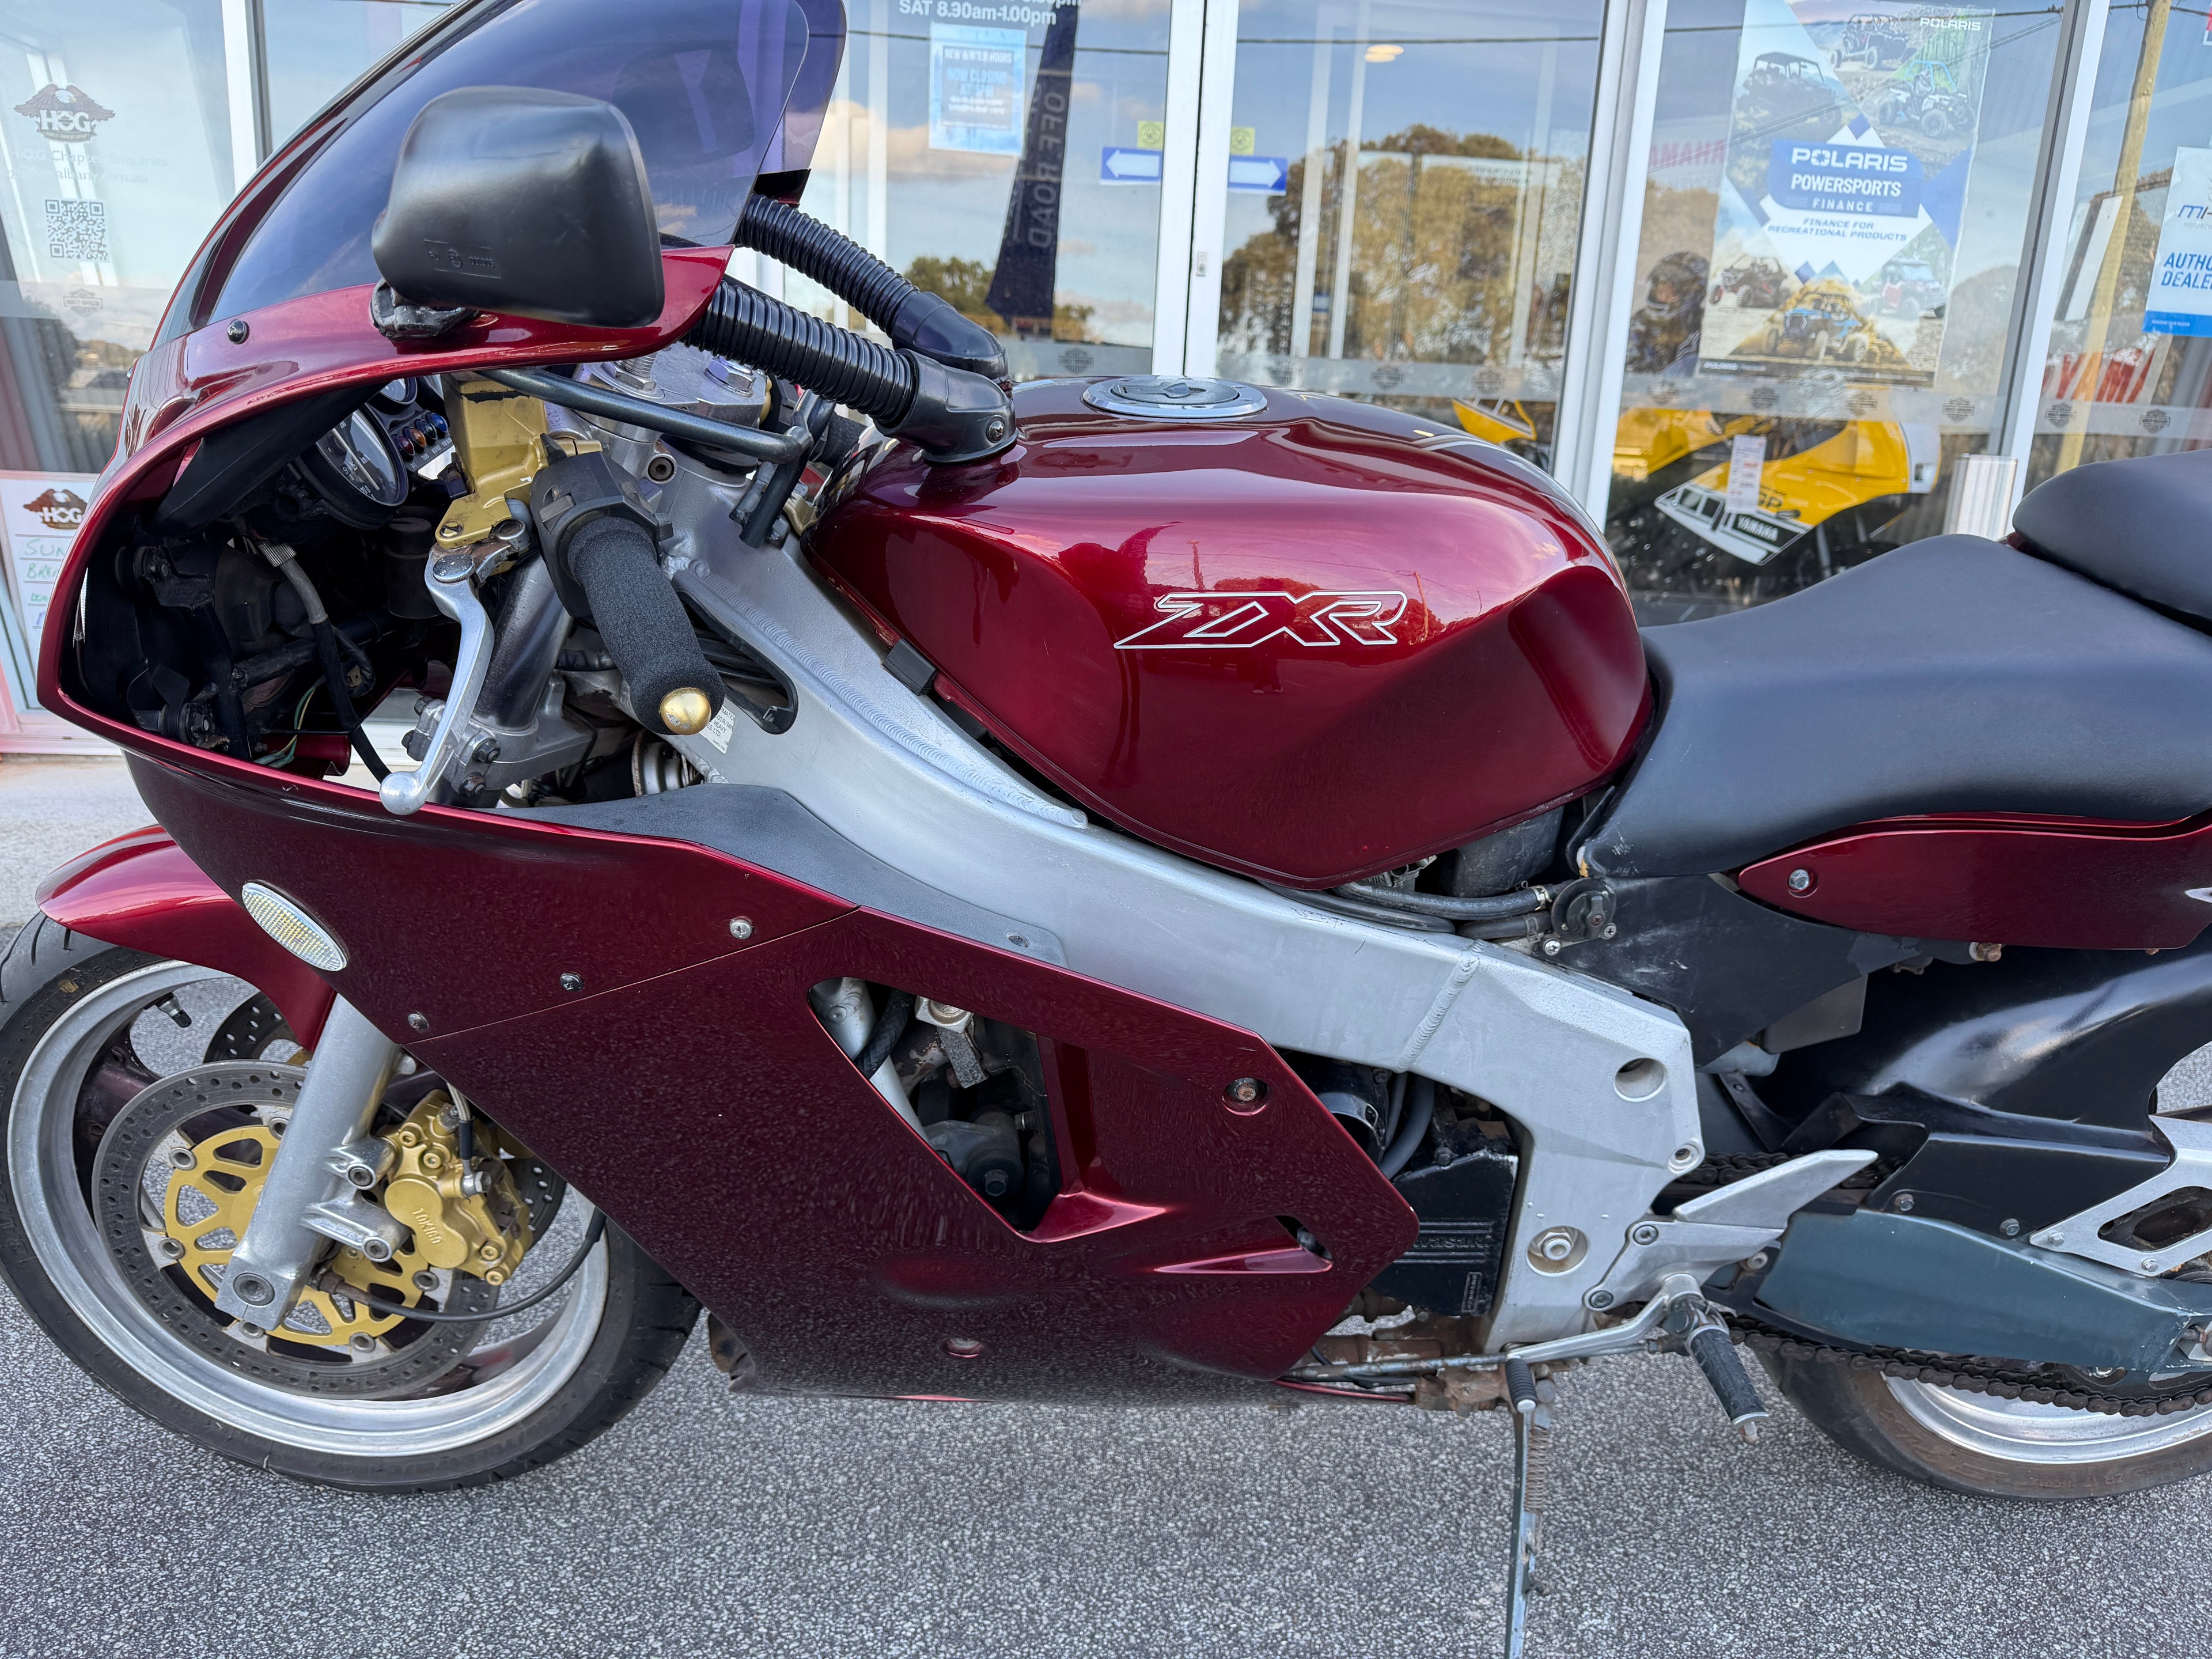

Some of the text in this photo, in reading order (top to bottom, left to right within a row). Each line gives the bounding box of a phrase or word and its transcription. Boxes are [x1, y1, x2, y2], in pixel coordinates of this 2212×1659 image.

[899, 0, 933, 16] SAT
[1919, 17, 1982, 31] POLARIS
[40, 110, 91, 132] HOG
[1649, 138, 1726, 166] AMAHA
[1791, 147, 1908, 172] POLARIS
[1791, 173, 1902, 196] POWERSPORTS
[1812, 198, 1874, 213] FINANCE
[1803, 217, 1874, 230] FINANCE FOR
[1768, 225, 1907, 242] RECREATIONAL PRODUCTS
[42, 507, 82, 523] HOG
[1736, 514, 1779, 542] YAMAHA
[1114, 591, 1407, 649] ZXR
[714, 720, 726, 733] HEAVY
[1423, 897, 1441, 906] FUEL
[412, 1208, 442, 1244] TOKICO
[1412, 1234, 1493, 1249] wasaki
